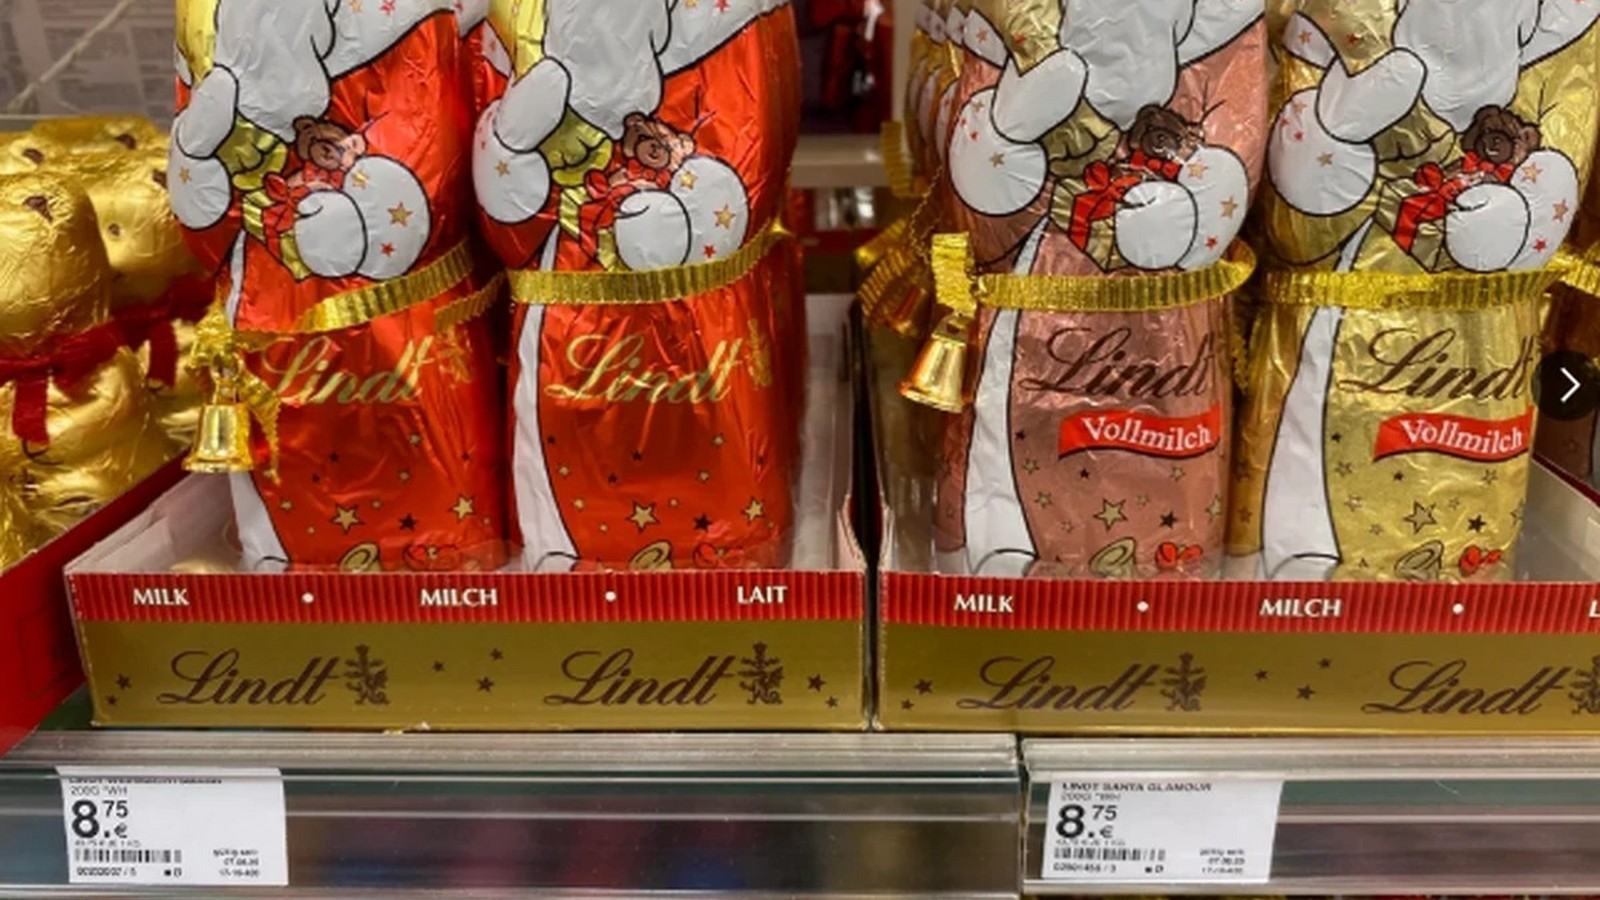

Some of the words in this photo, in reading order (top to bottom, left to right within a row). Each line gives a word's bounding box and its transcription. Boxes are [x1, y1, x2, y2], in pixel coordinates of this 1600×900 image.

[261, 334, 436, 404] Lindt
[544, 334, 743, 404] Lindt
[1018, 327, 1222, 399] Lindt
[1338, 327, 1535, 399] Lindt
[1081, 413, 1212, 452] Vollmilch
[1400, 414, 1523, 453] Vollmilch
[133, 587, 189, 606] MILK
[420, 587, 498, 607] MILCH
[737, 585, 788, 604] LAIT
[954, 594, 1014, 614] MILK
[1260, 597, 1342, 617] MILCH
[160, 648, 343, 705] Lindt
[546, 648, 737, 705] Lindt
[957, 655, 1162, 711] Lindt
[1361, 660, 1574, 715] Lindt
[1102, 783, 1144, 792] SANTA
[1147, 783, 1212, 792] GLAMOUR
